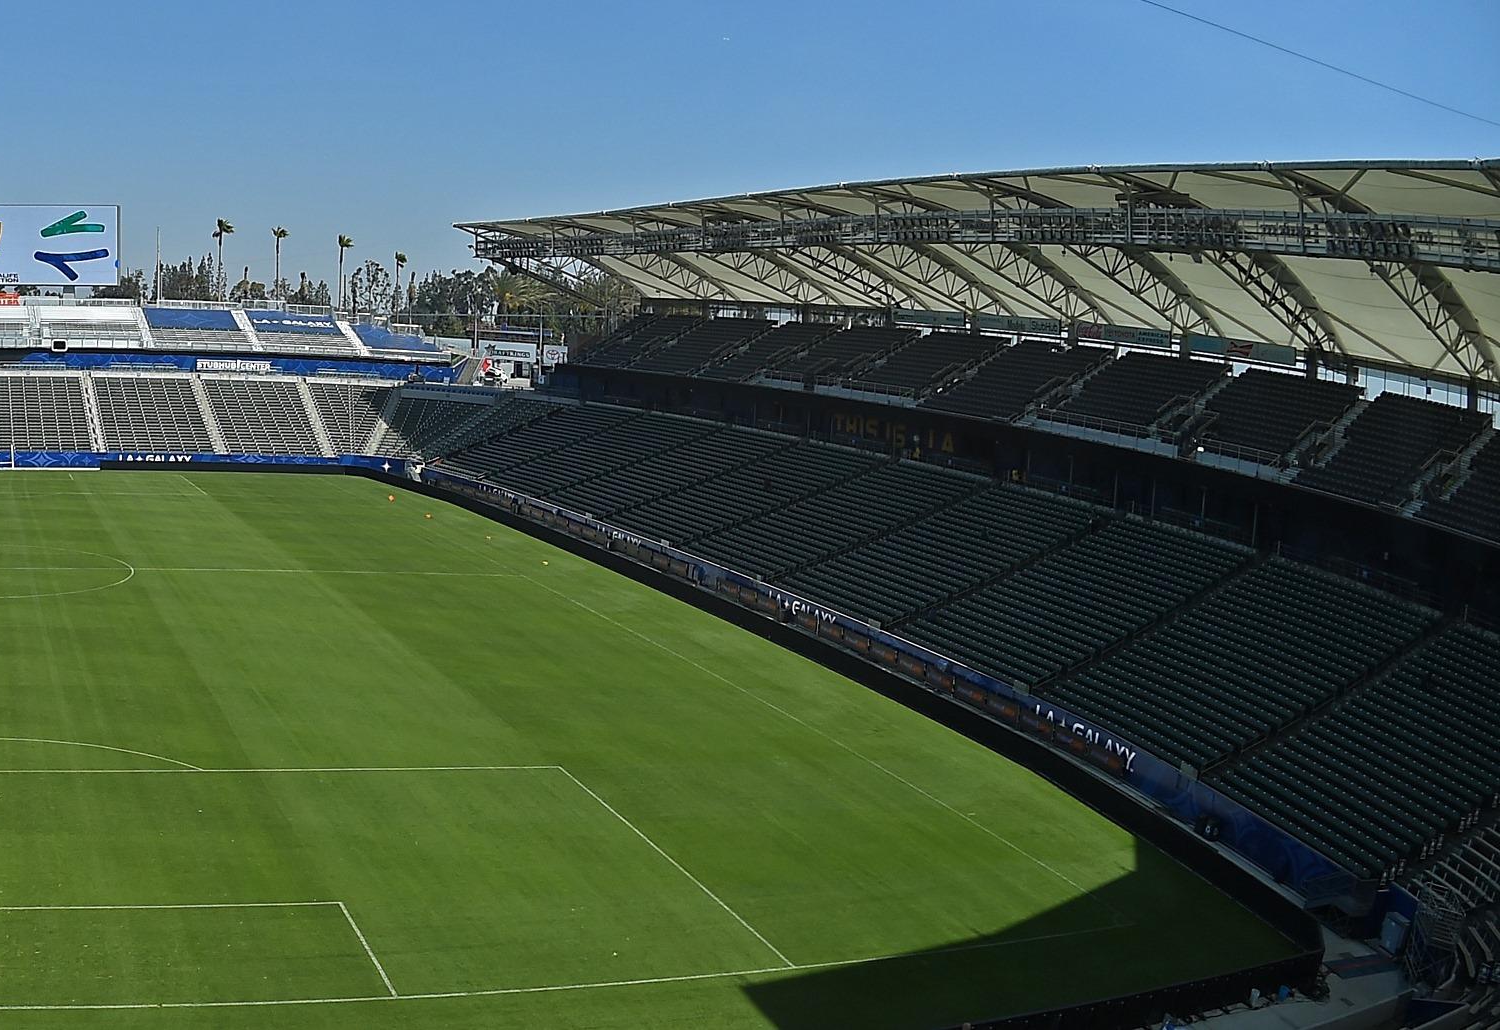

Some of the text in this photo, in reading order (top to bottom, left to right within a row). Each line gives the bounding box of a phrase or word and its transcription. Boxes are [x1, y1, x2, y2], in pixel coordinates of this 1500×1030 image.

[1138, 330, 1169, 339] AMERICAN
[196, 361, 271, 371] STUBHUB CENTER
